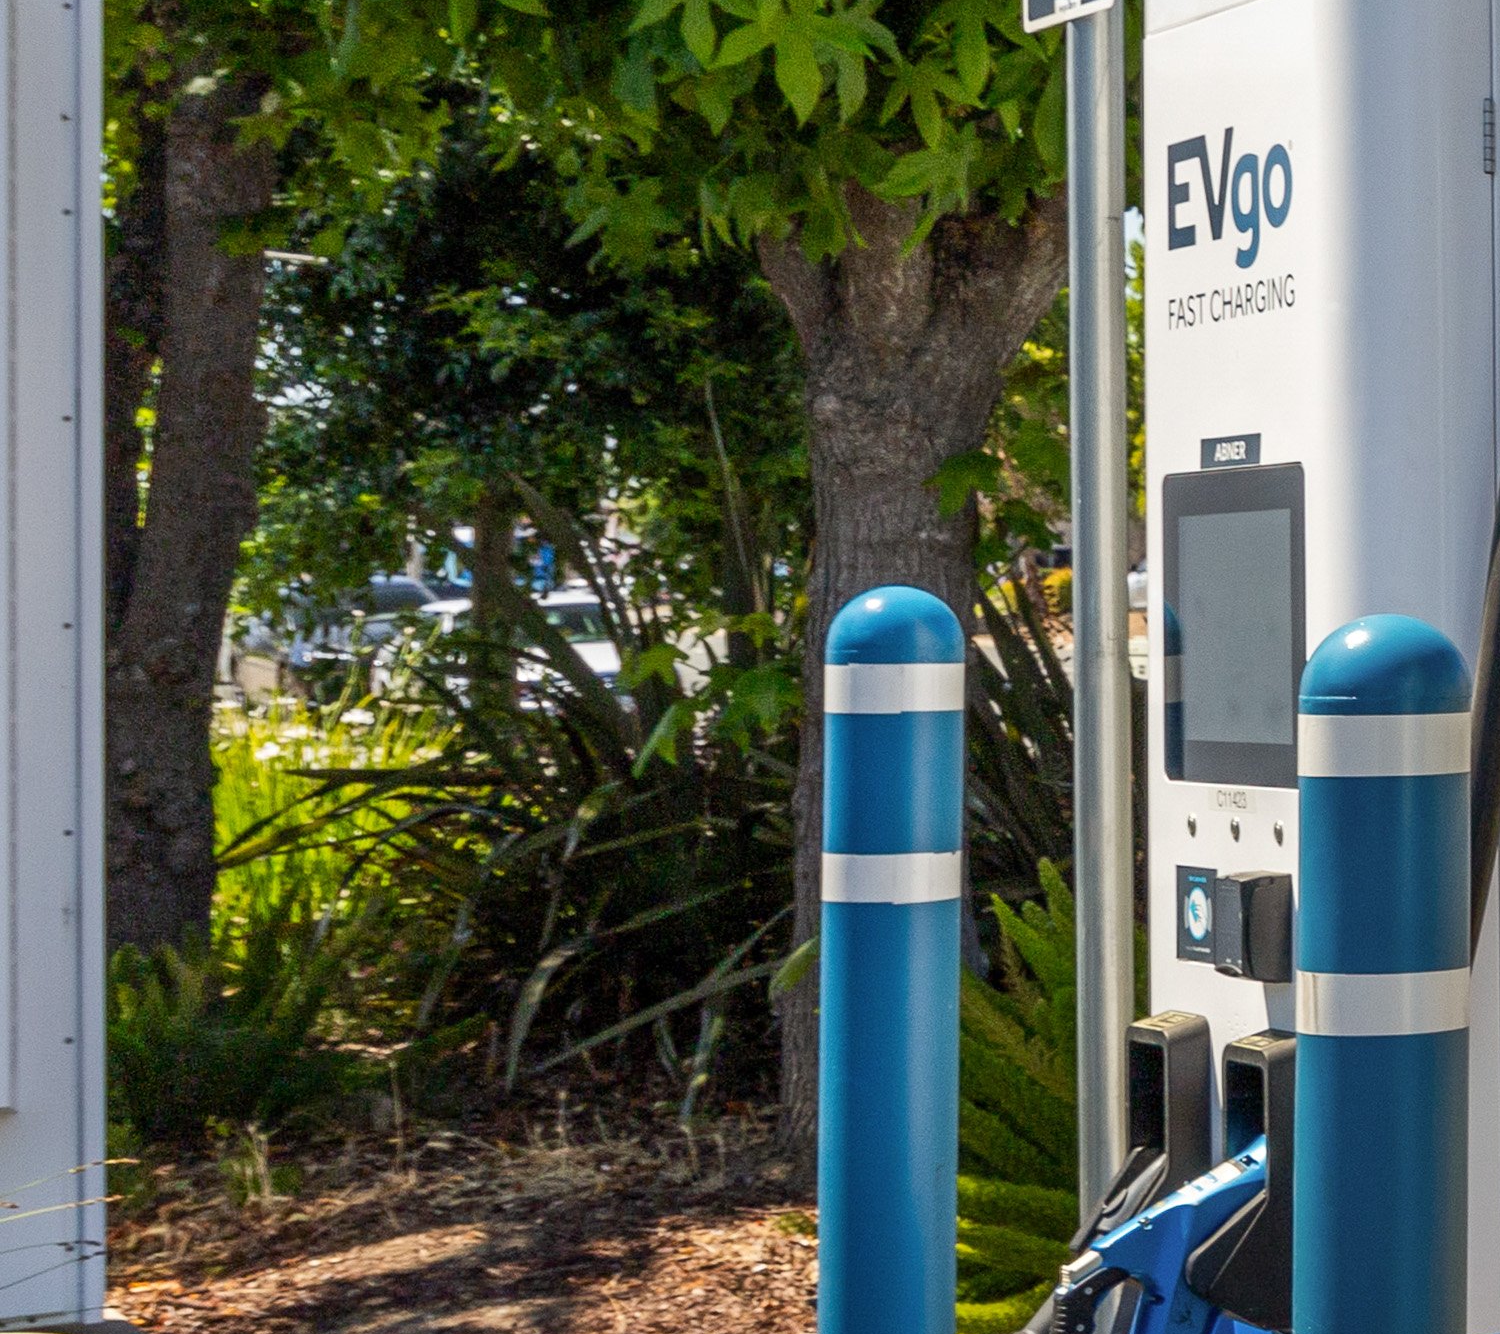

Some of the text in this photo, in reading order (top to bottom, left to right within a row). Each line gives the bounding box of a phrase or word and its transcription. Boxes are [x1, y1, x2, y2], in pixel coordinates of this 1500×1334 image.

[1168, 127, 1292, 269] EVgo
[1169, 274, 1295, 330] FAST CHARGING
[1214, 441, 1246, 461] ABNER
